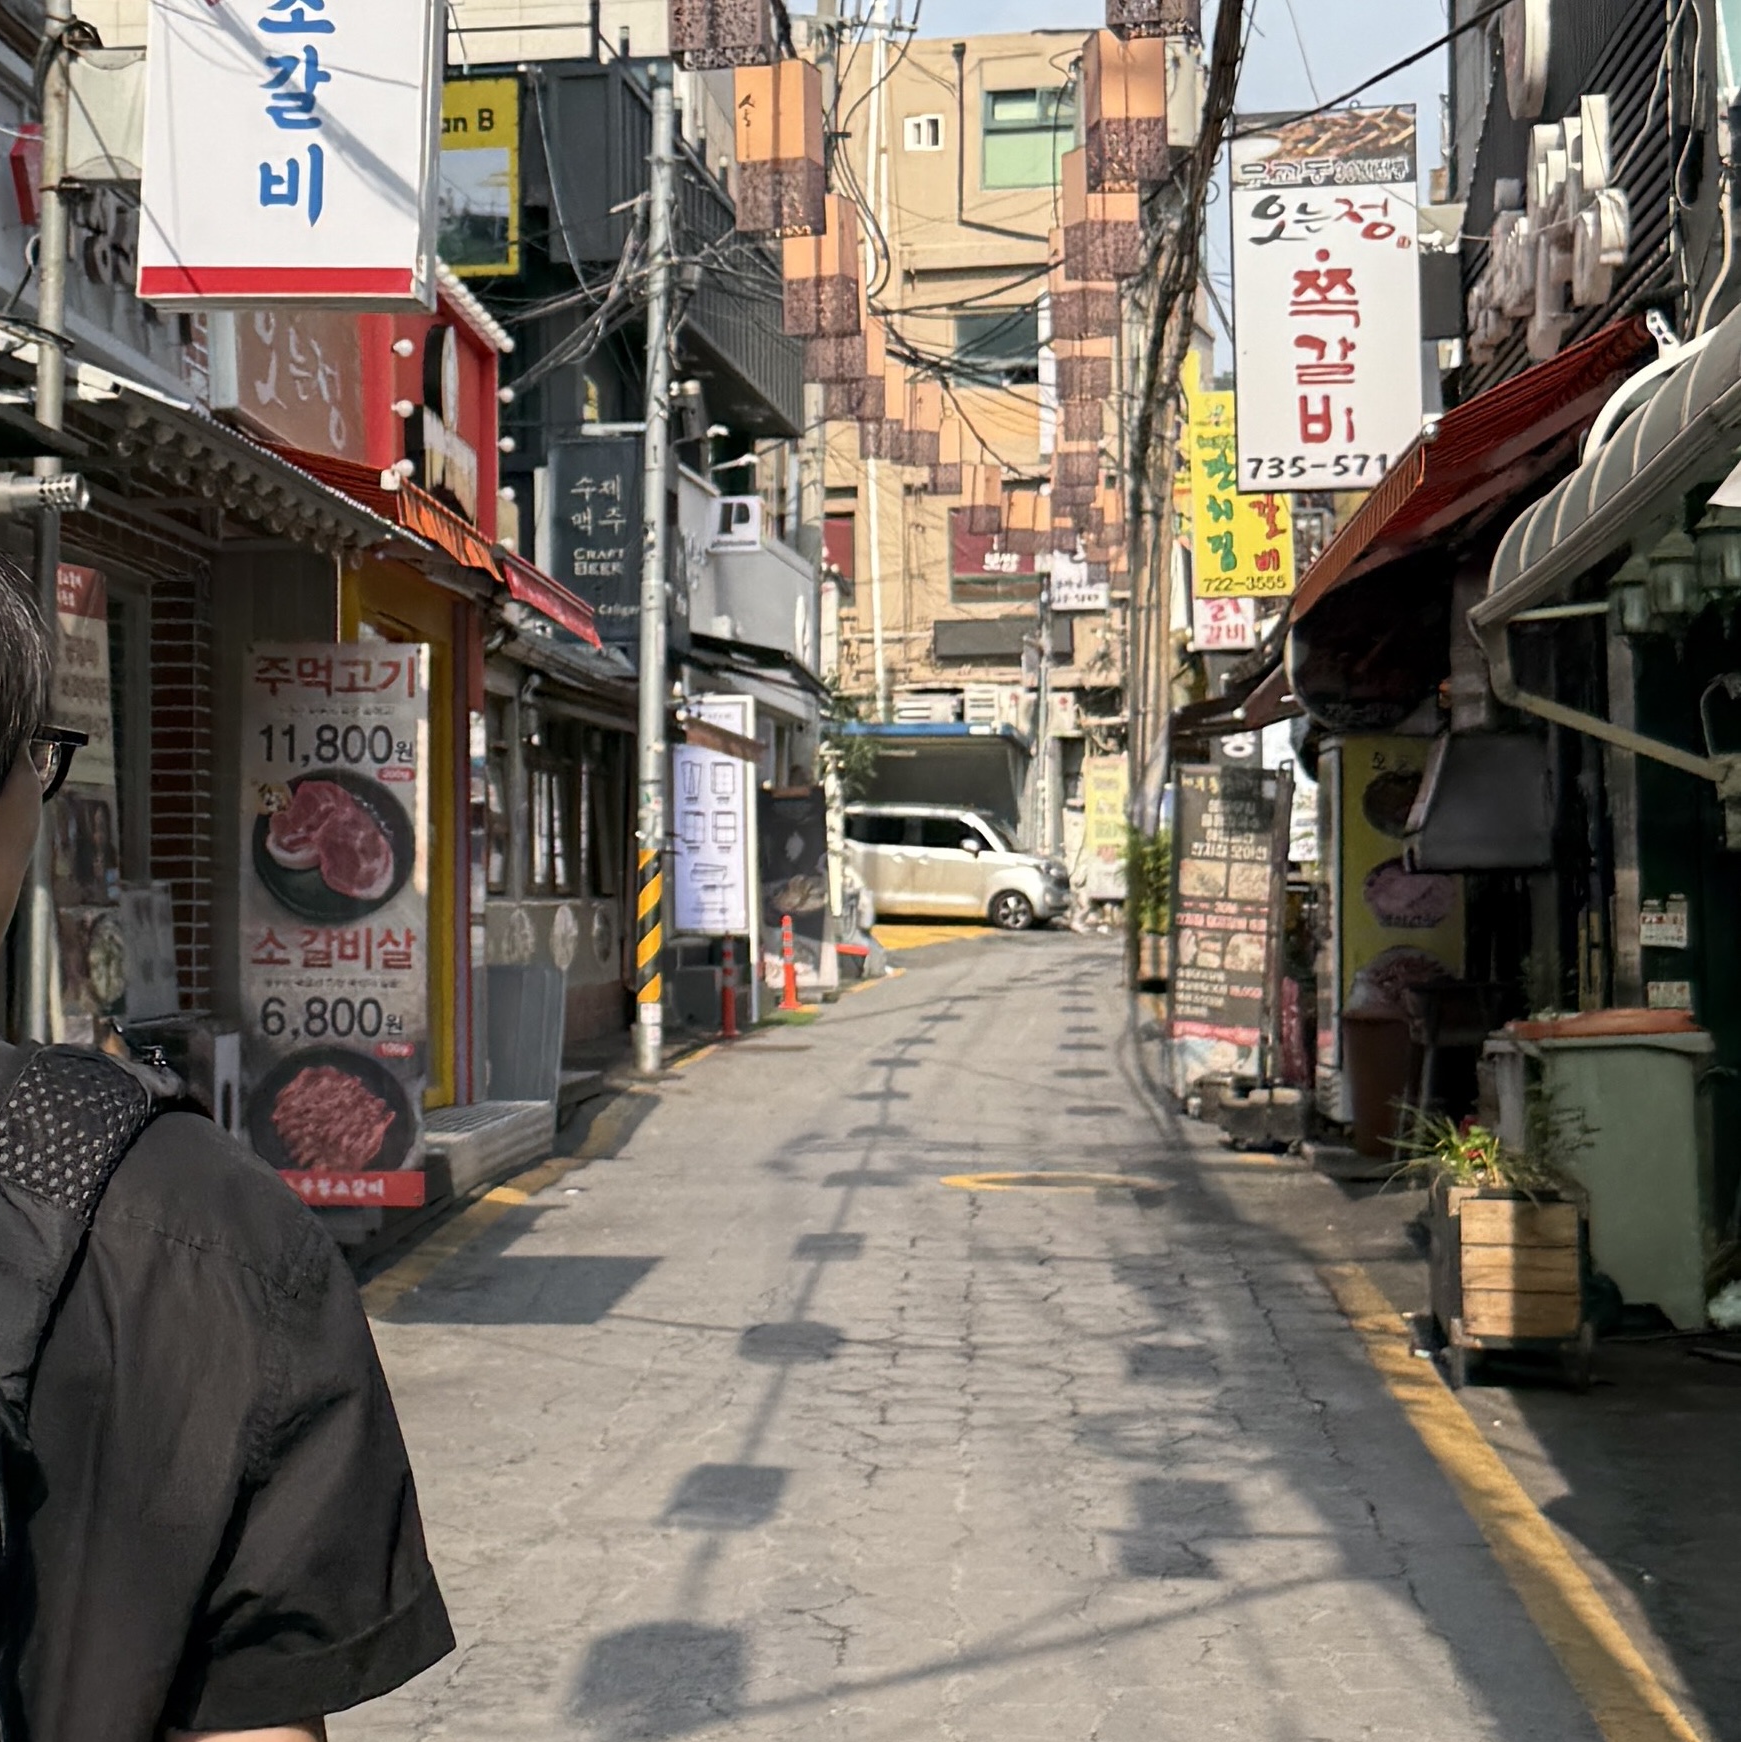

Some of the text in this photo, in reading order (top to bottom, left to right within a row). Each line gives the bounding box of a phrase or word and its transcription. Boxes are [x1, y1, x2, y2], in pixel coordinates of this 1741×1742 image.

[478, 108, 494, 132] B
[1288, 248, 1361, 444] 쪽갈비
[570, 474, 621, 502] 수제
[571, 506, 627, 537] 맥주
[573, 548, 625, 561] CRAFT
[254, 656, 415, 698] 주먹고기
